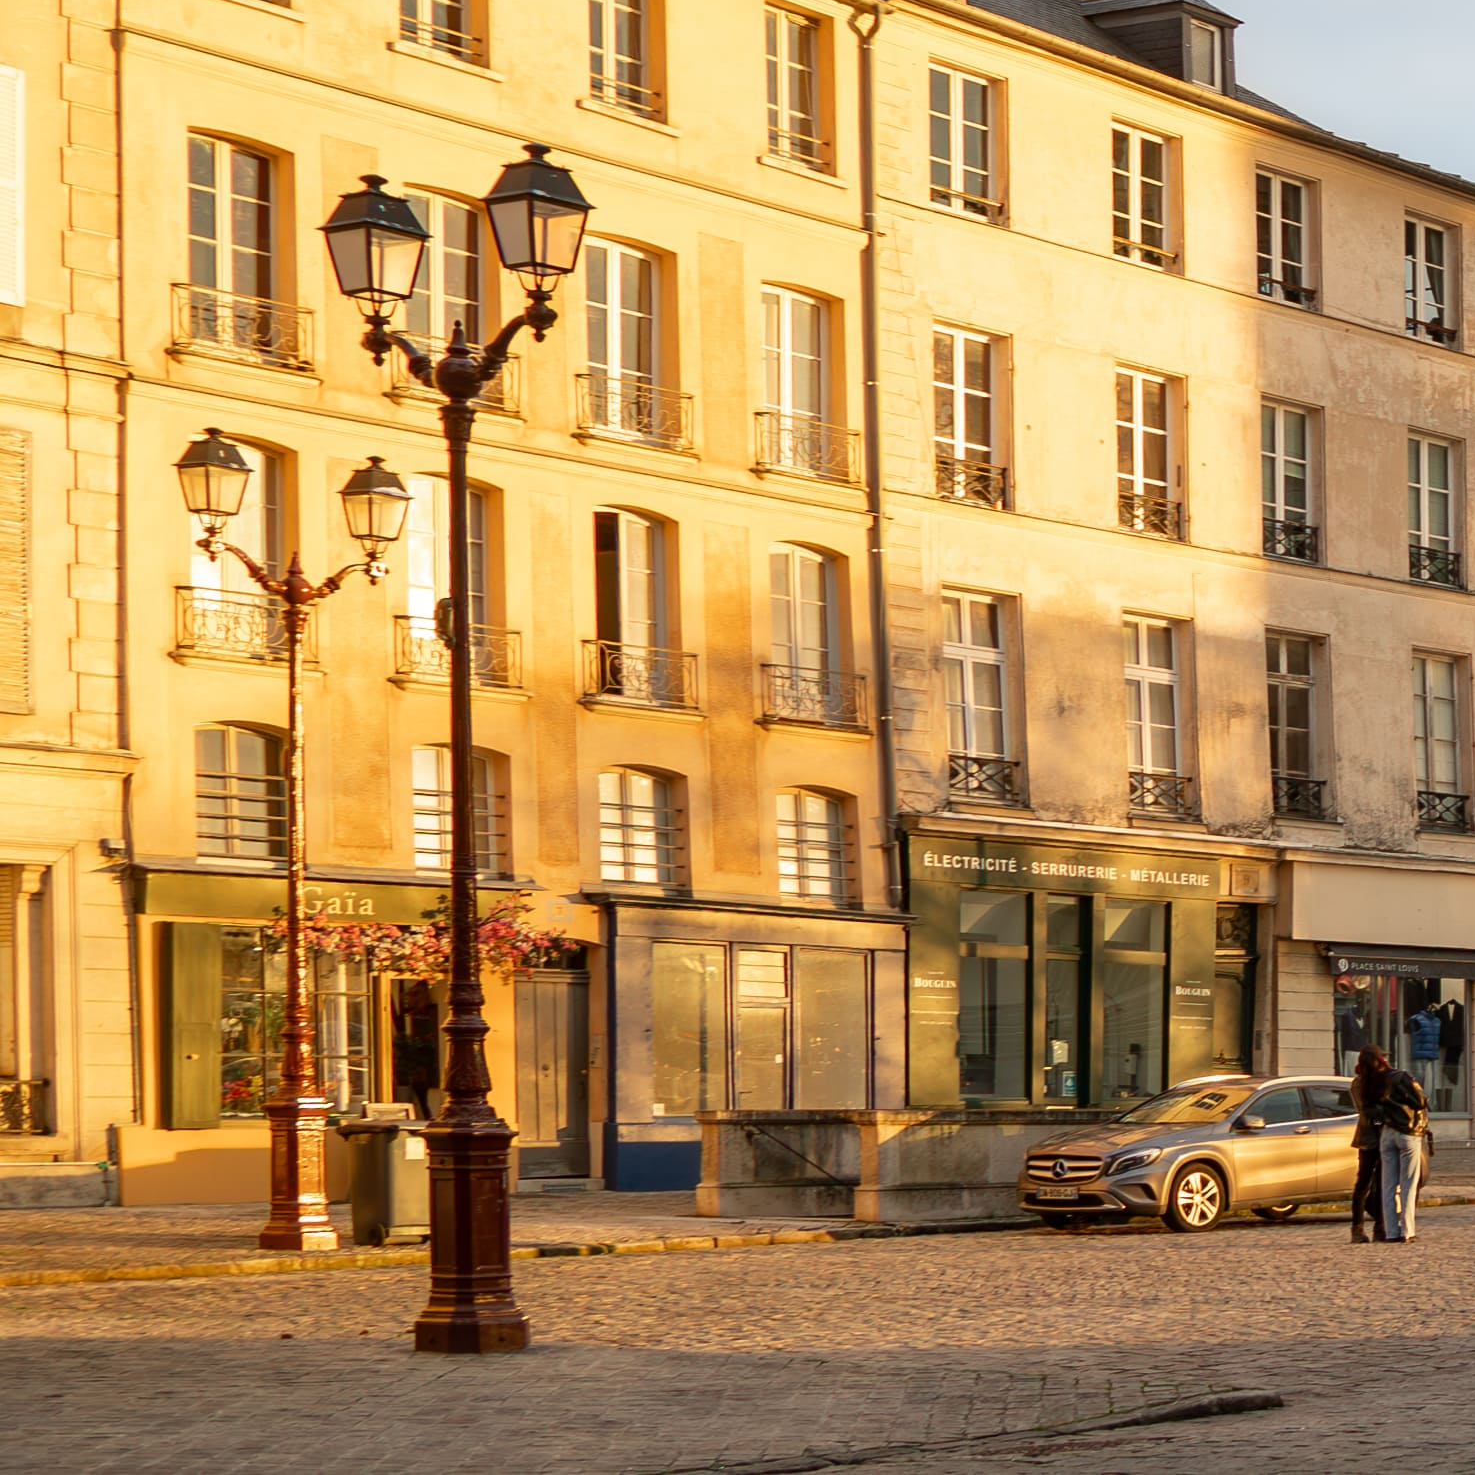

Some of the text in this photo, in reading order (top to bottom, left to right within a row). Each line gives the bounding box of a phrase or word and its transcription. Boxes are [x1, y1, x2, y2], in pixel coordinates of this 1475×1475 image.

[923, 851, 1018, 873] ÉLECTRICITÉ
[1031, 861, 1118, 880] SERRURERIE
[1130, 867, 1210, 887] MÉTALLERIE
[303, 886, 376, 916] Gaïa
